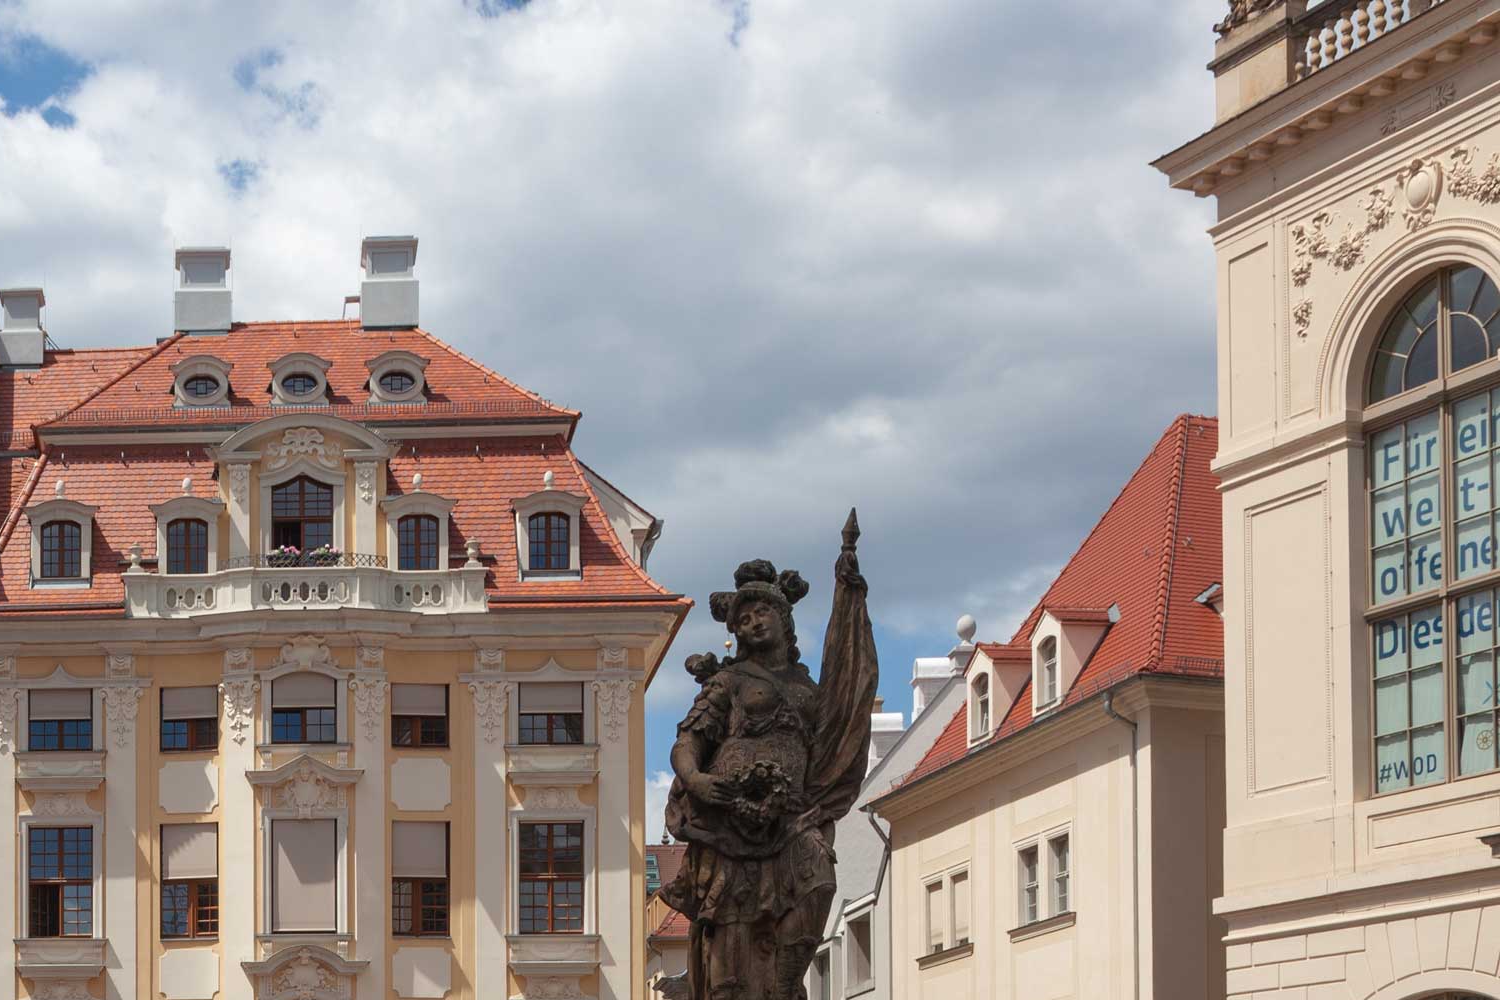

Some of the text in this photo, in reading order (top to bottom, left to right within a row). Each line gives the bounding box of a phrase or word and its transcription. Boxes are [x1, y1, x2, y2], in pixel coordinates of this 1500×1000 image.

[1382, 431, 1437, 482] Für
[1378, 597, 1500, 660] Dresde
[1379, 753, 1437, 784] #WOD
